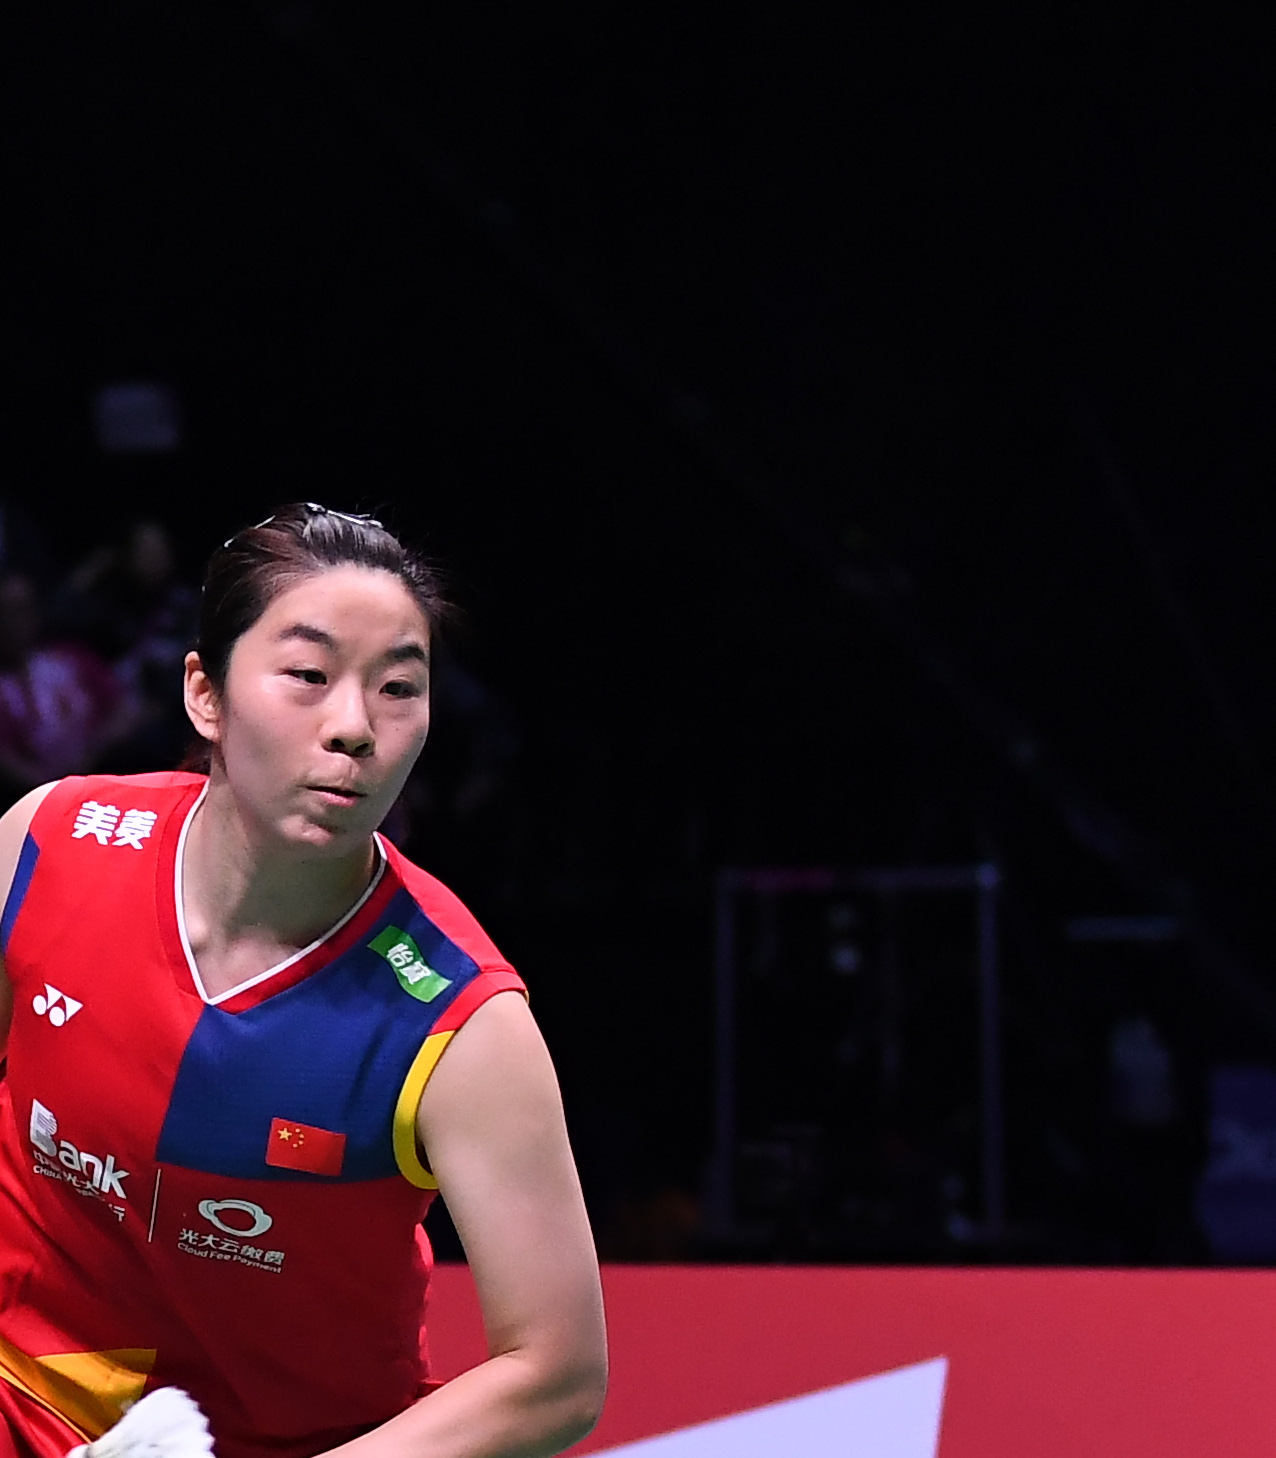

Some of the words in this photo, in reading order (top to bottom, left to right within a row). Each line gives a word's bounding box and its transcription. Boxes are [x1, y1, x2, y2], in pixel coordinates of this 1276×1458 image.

[29, 1097, 130, 1200] Bank
[177, 1241, 209, 1259] Cloud
[209, 1250, 232, 1261] Fee
[232, 1253, 283, 1274] Payment
